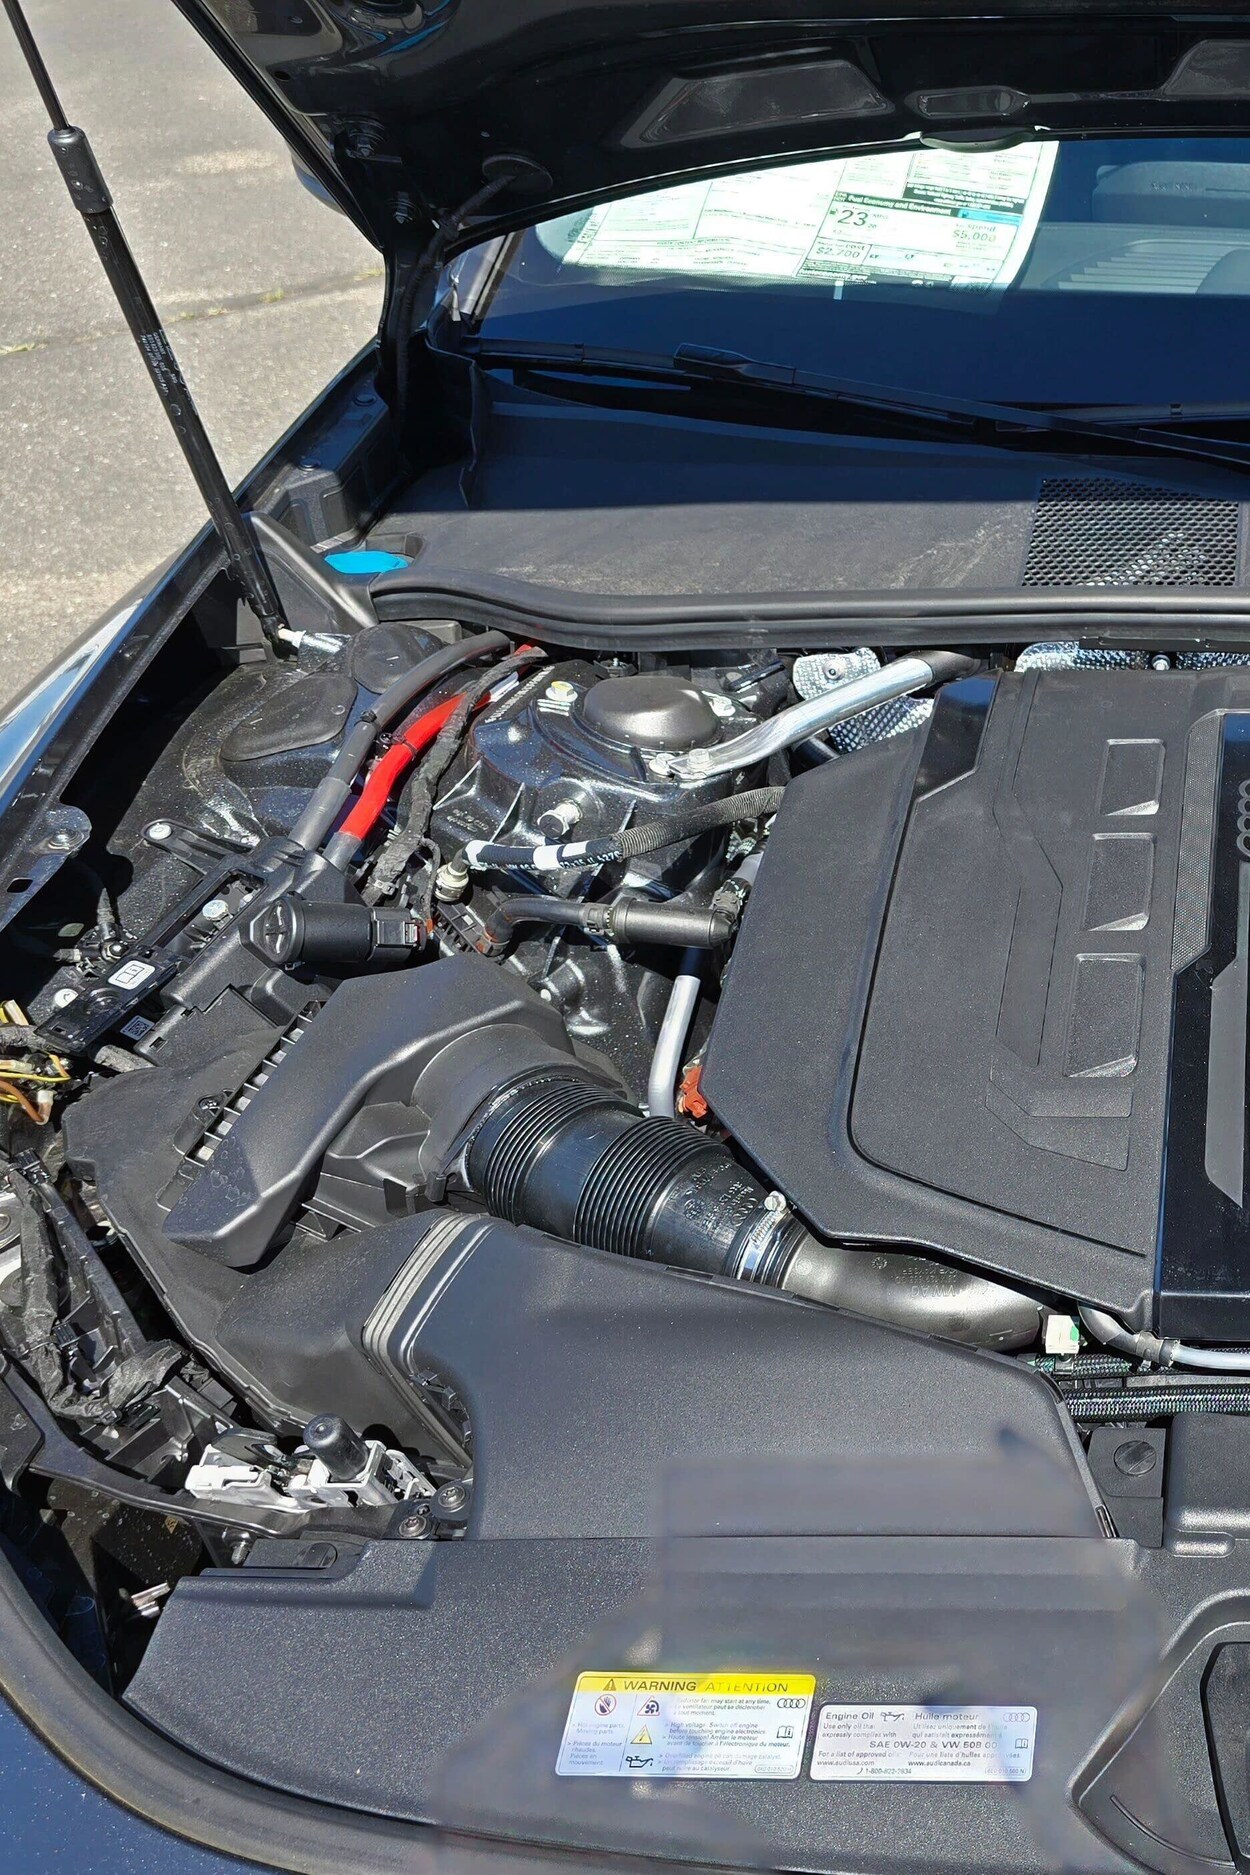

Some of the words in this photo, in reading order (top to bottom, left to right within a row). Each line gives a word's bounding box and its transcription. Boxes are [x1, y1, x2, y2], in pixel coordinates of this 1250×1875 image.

[895, 201, 909, 210] and
[837, 209, 868, 227] 23
[624, 1681, 698, 1692] WARNING
[704, 1682, 789, 1692] ATTENTION
[826, 1712, 858, 1721] Engine
[861, 1712, 874, 1720] Oil
[915, 1712, 940, 1720] Huile
[822, 1732, 852, 1740] expressly
